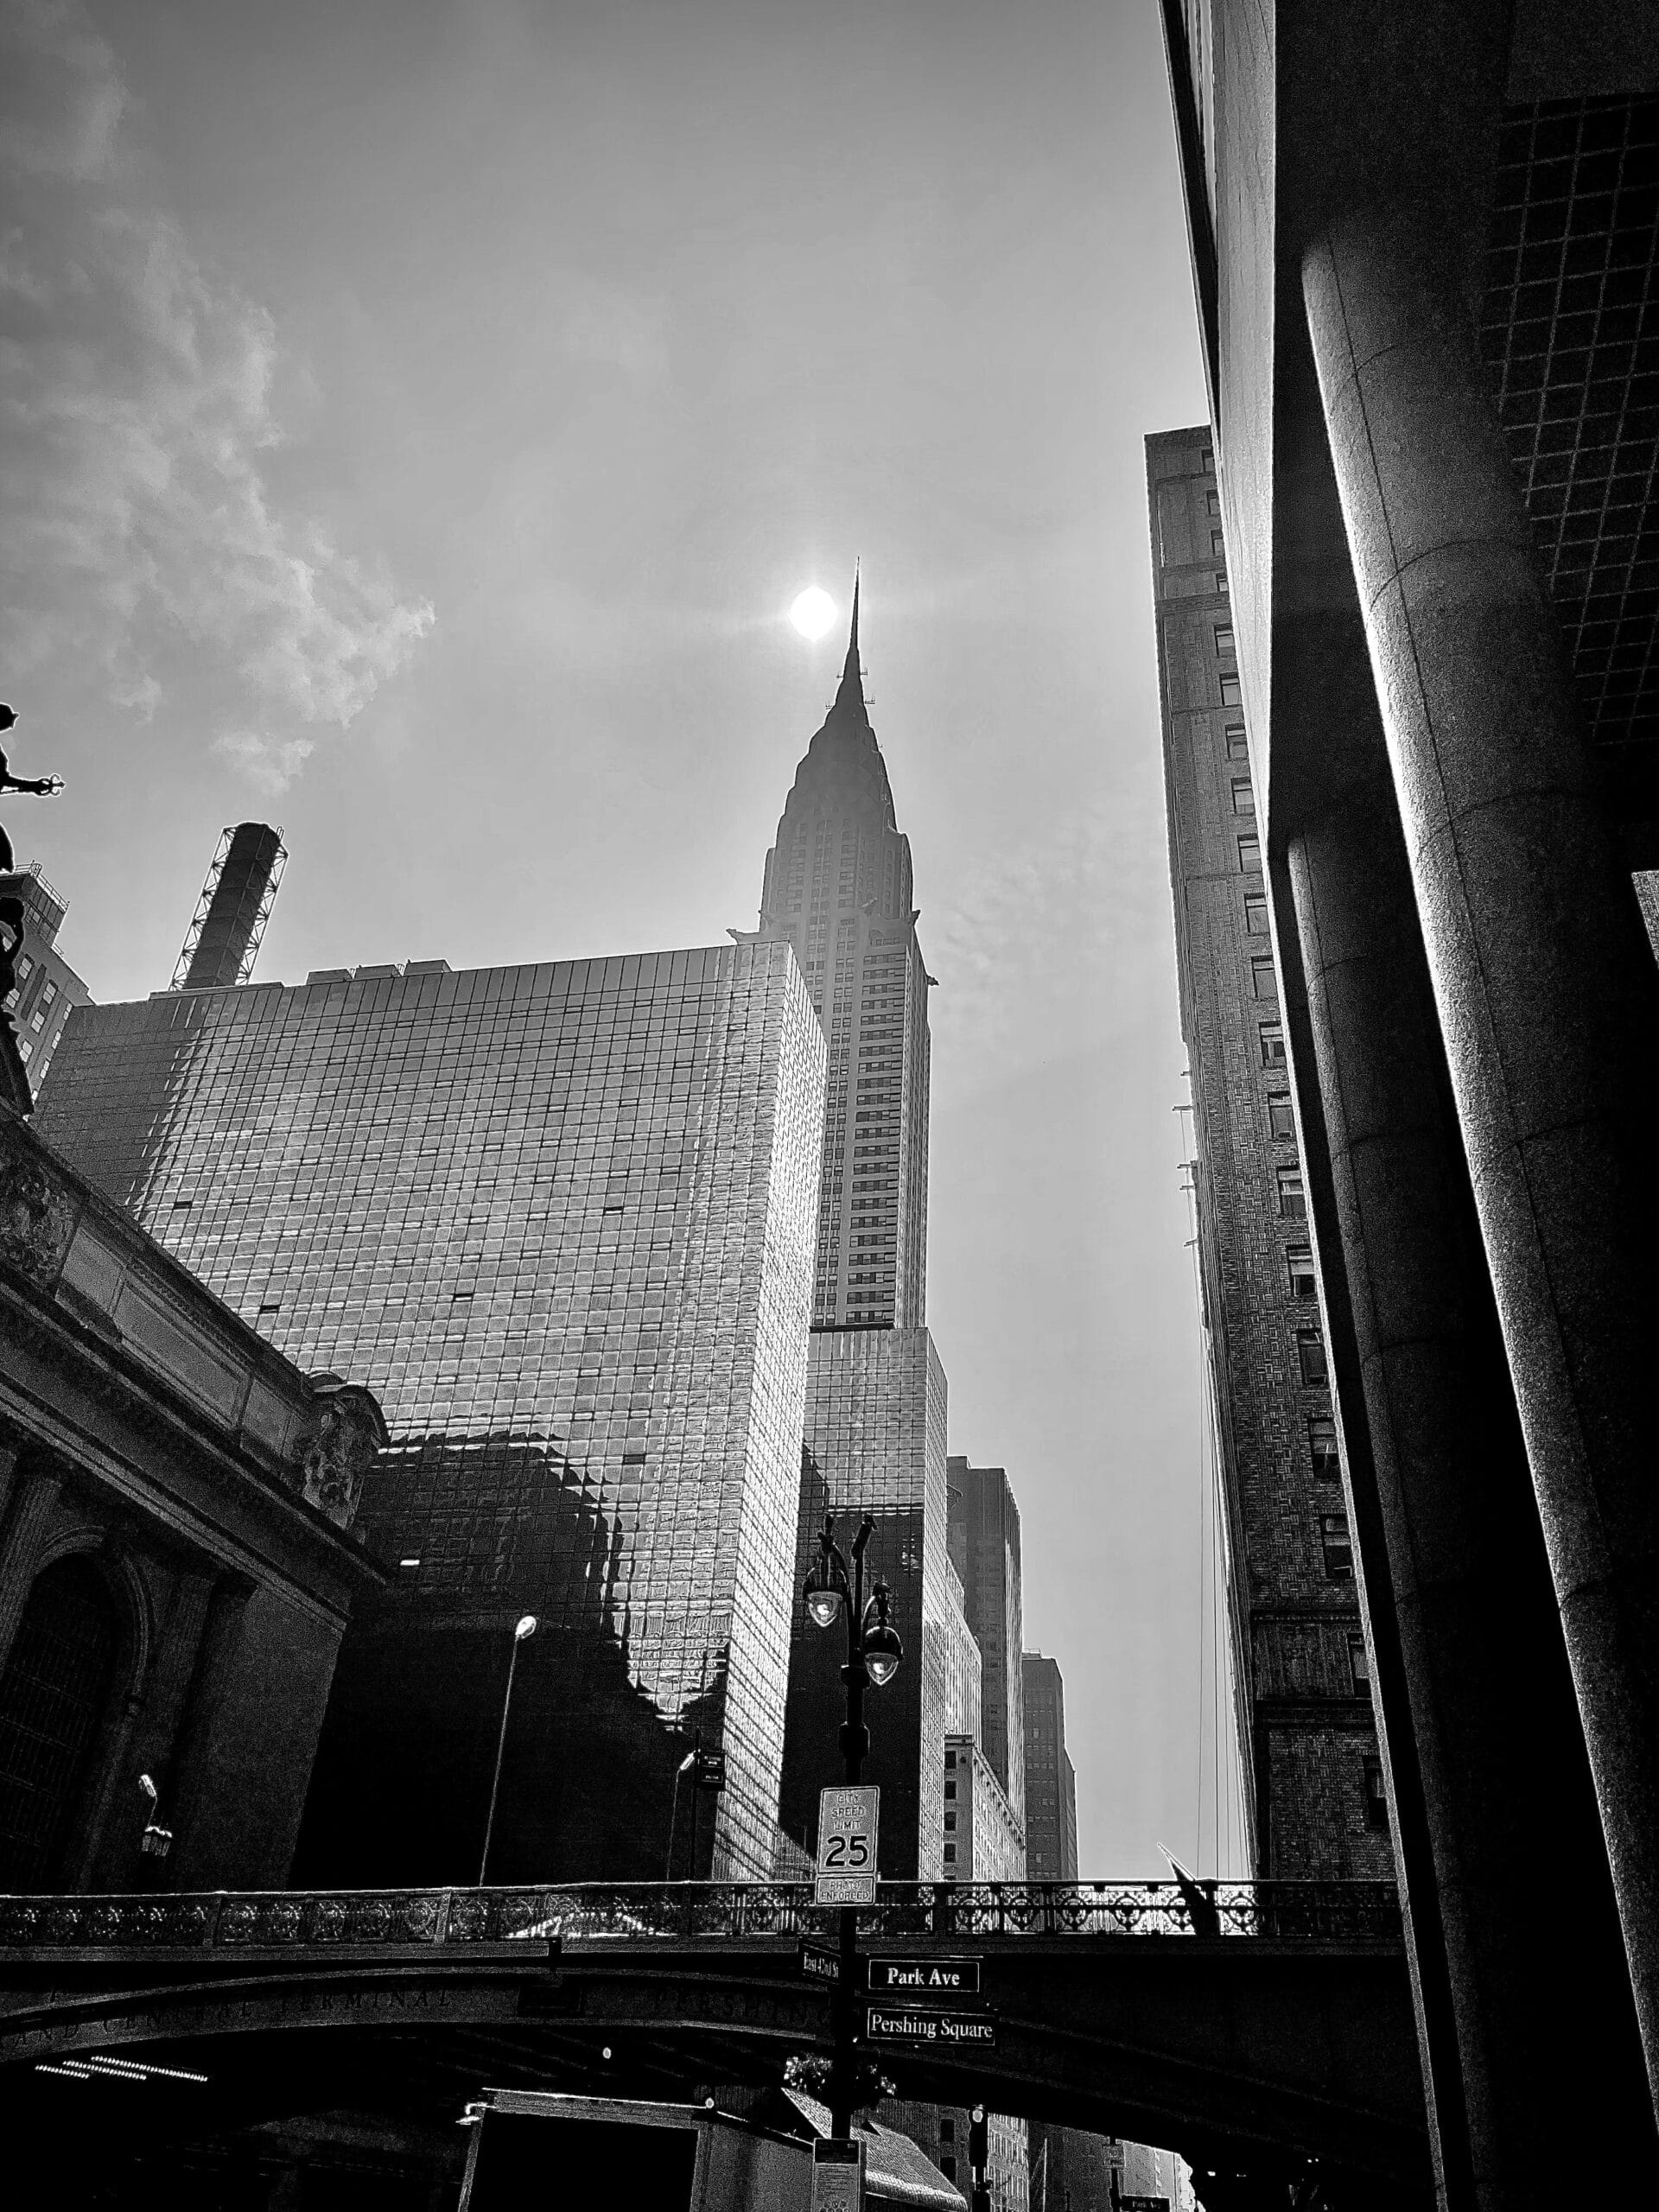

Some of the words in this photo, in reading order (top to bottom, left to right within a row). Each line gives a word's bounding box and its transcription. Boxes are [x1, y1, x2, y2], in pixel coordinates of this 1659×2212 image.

[837, 1793, 860, 1804] CITY
[831, 1807, 865, 1817] SPEED
[833, 1820, 861, 1830] LIMIT
[825, 1835, 868, 1867] 25
[829, 1880, 861, 1891] PHOTO
[821, 1891, 870, 1901] ENFORCED
[804, 1951, 817, 1973] East
[887, 1967, 925, 1986] Park
[929, 1967, 961, 1986] Ave
[871, 2013, 938, 2039] Pershing
[941, 2018, 994, 2041] Square
